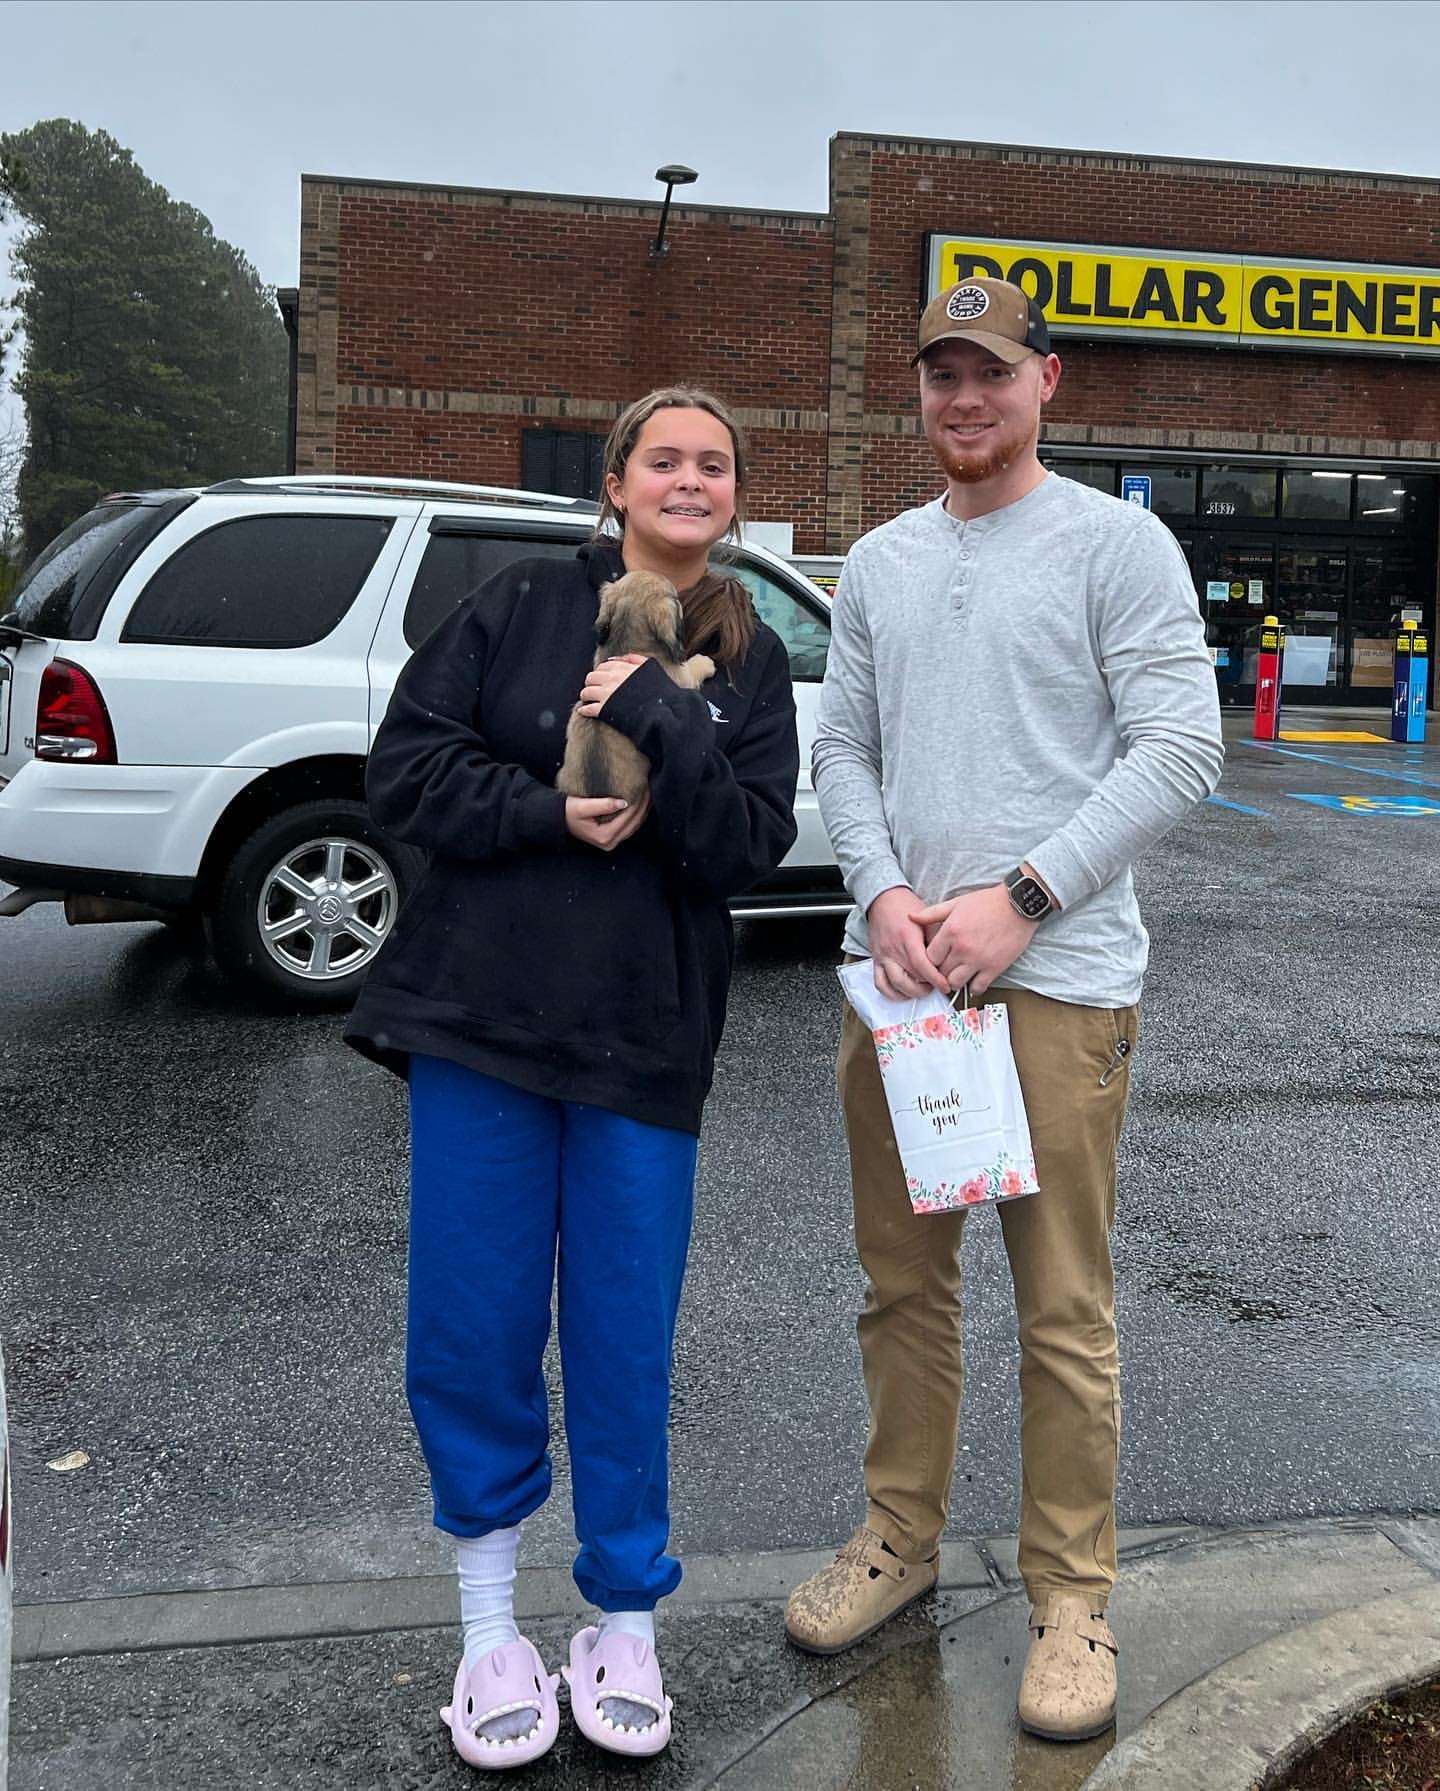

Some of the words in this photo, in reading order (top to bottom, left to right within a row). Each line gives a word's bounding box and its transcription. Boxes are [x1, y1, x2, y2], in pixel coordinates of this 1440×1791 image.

[953, 253, 1227, 326] DOLLAR
[913, 1088, 961, 1115] thank
[932, 1113, 960, 1135] you
